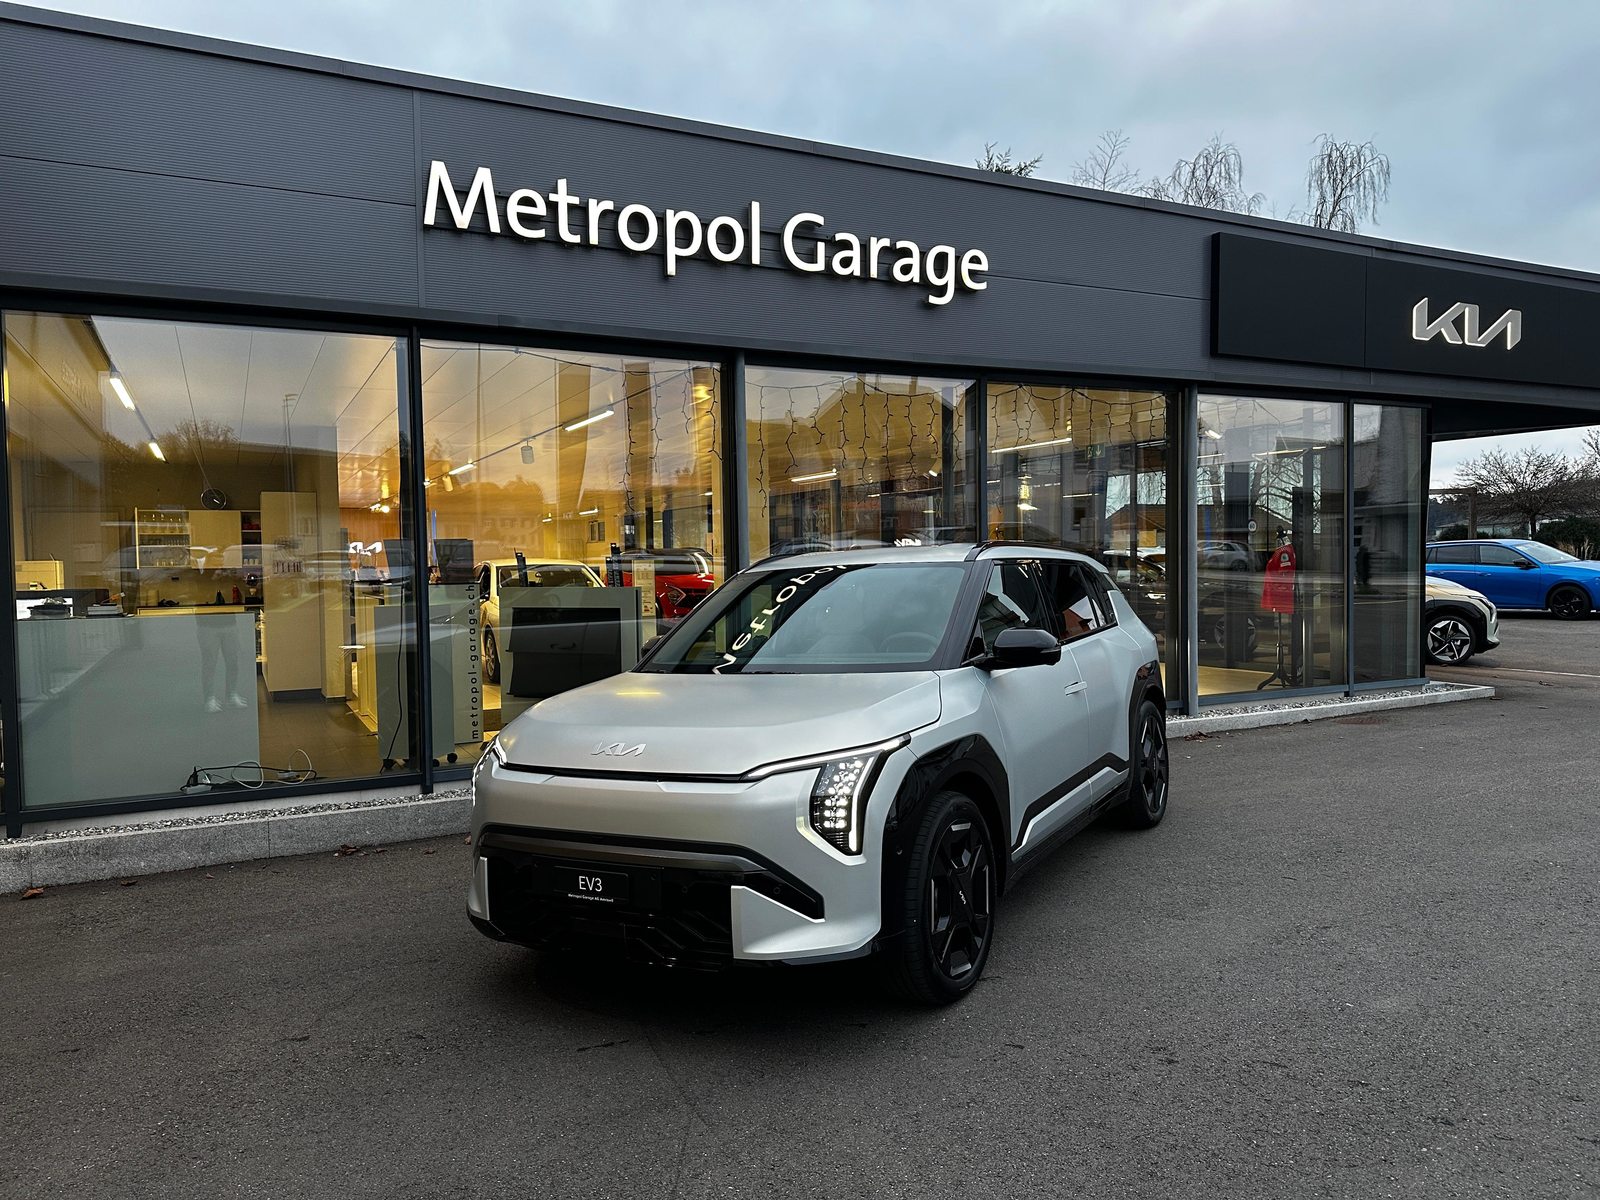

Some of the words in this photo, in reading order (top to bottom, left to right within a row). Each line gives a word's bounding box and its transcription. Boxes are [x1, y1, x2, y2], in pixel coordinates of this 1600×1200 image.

[423, 159, 761, 277] Metropol
[781, 212, 989, 305] Garage
[1412, 297, 1522, 350] KIA
[466, 584, 479, 740] metropol-garage.ch
[591, 740, 647, 757] KIA
[578, 875, 603, 892] EV3
